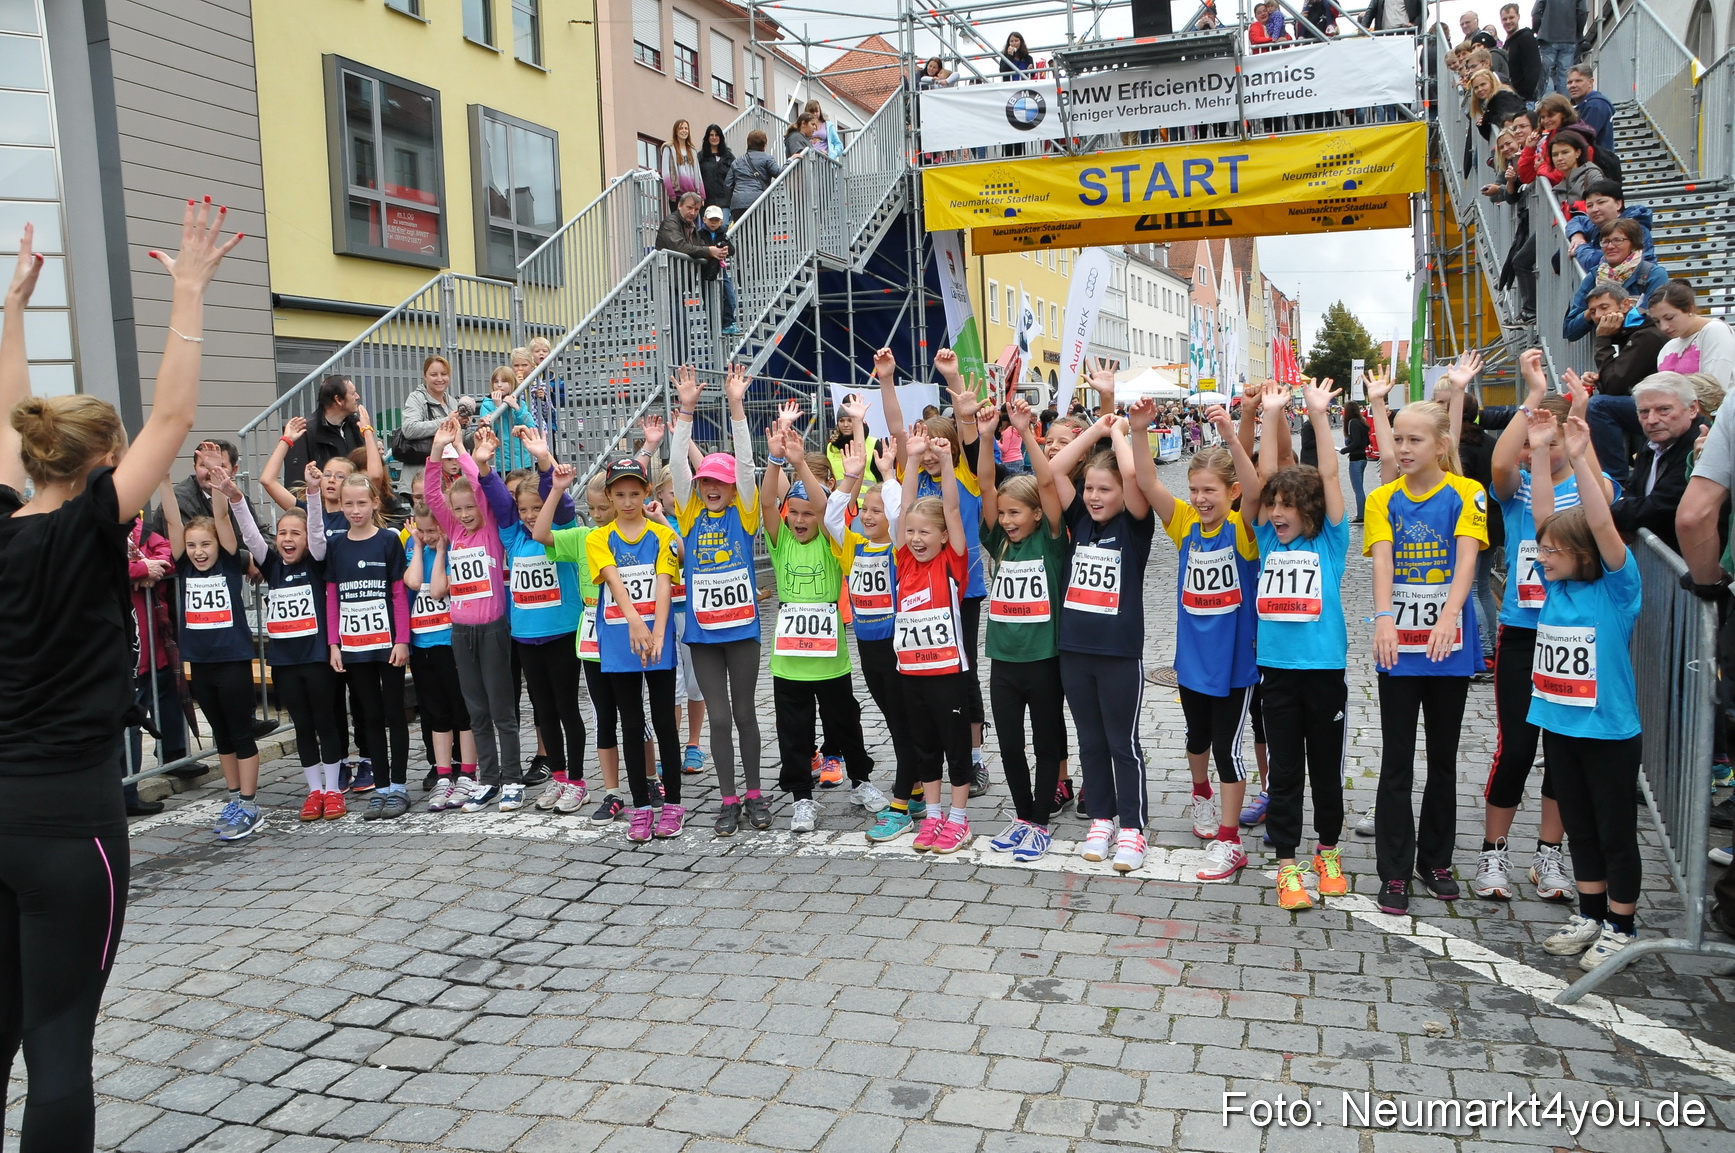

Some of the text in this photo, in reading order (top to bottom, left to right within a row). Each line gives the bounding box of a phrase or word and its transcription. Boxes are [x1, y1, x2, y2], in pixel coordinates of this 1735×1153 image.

[1116, 101, 1191, 118] Verbrauch.
[1196, 95, 1231, 109] Mehr
[1078, 154, 1249, 206] START
[1281, 163, 1396, 181] Neumarkter Stadtlauf
[949, 192, 1050, 208] Neumarkter Stadtlauf
[1069, 307, 1090, 374] Audi BKK
[451, 559, 484, 581] 180
[1194, 556, 1227, 565] Neumarkt
[514, 567, 554, 589] 7065
[712, 576, 740, 585] Neumarkt
[1072, 561, 1116, 589] 7555
[1187, 563, 1234, 591] 7020
[1264, 568, 1316, 594] 7117
[698, 583, 748, 608] 7560
[996, 575, 1043, 599] 7076
[186, 589, 226, 609] 7545
[519, 593, 547, 602] Samina
[1194, 597, 1222, 606] Maria
[1267, 600, 1308, 612] Franziska
[270, 598, 311, 619] 7552
[1003, 604, 1031, 616] Svenja
[1393, 601, 1447, 627] 713
[342, 612, 384, 632] 7515
[784, 614, 833, 635] 7004
[910, 615, 941, 623] Neumarkt
[799, 639, 813, 648] Eva
[899, 623, 949, 647] 7113
[1403, 633, 1430, 643] Victo
[1545, 632, 1582, 642] Neumarkt
[915, 651, 938, 661] Paula
[1536, 642, 1589, 676] 7028
[1543, 679, 1573, 693] Alessia
